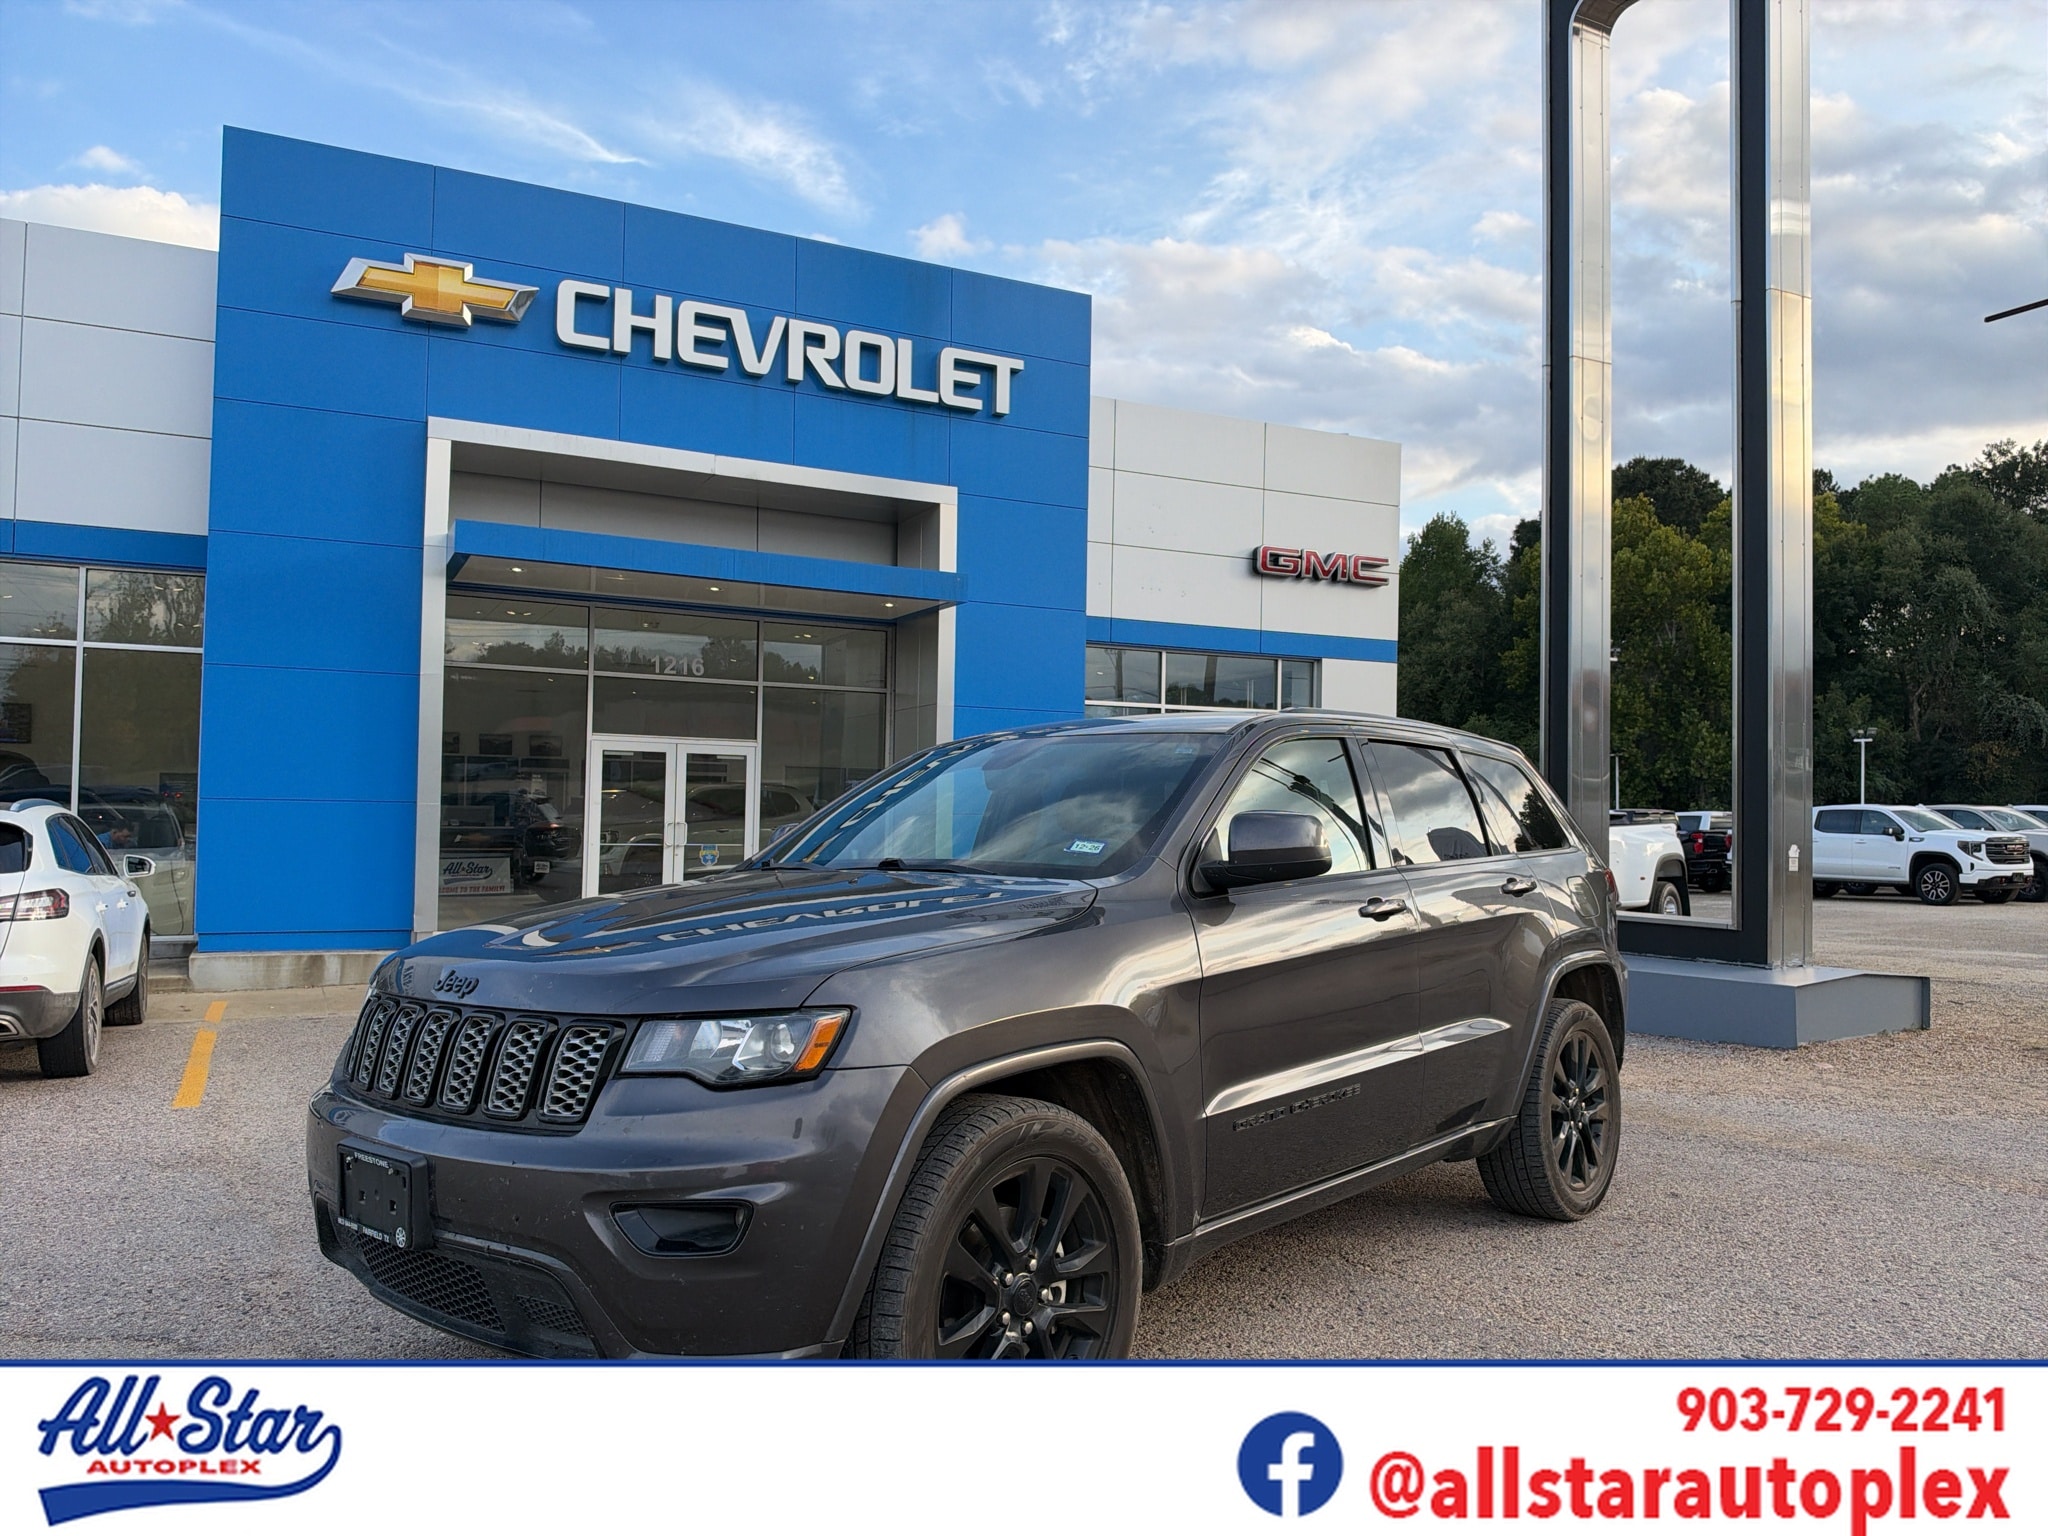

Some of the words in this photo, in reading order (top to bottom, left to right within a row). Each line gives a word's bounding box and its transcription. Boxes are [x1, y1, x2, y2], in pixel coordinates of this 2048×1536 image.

[556, 279, 1025, 417] CHEVROLET
[1255, 545, 1389, 586] GMC
[651, 655, 705, 676] 1216
[443, 862, 462, 875] All
[466, 861, 492, 874] Star
[433, 970, 480, 999] Jeep
[354, 1151, 390, 1169] FREESTONE
